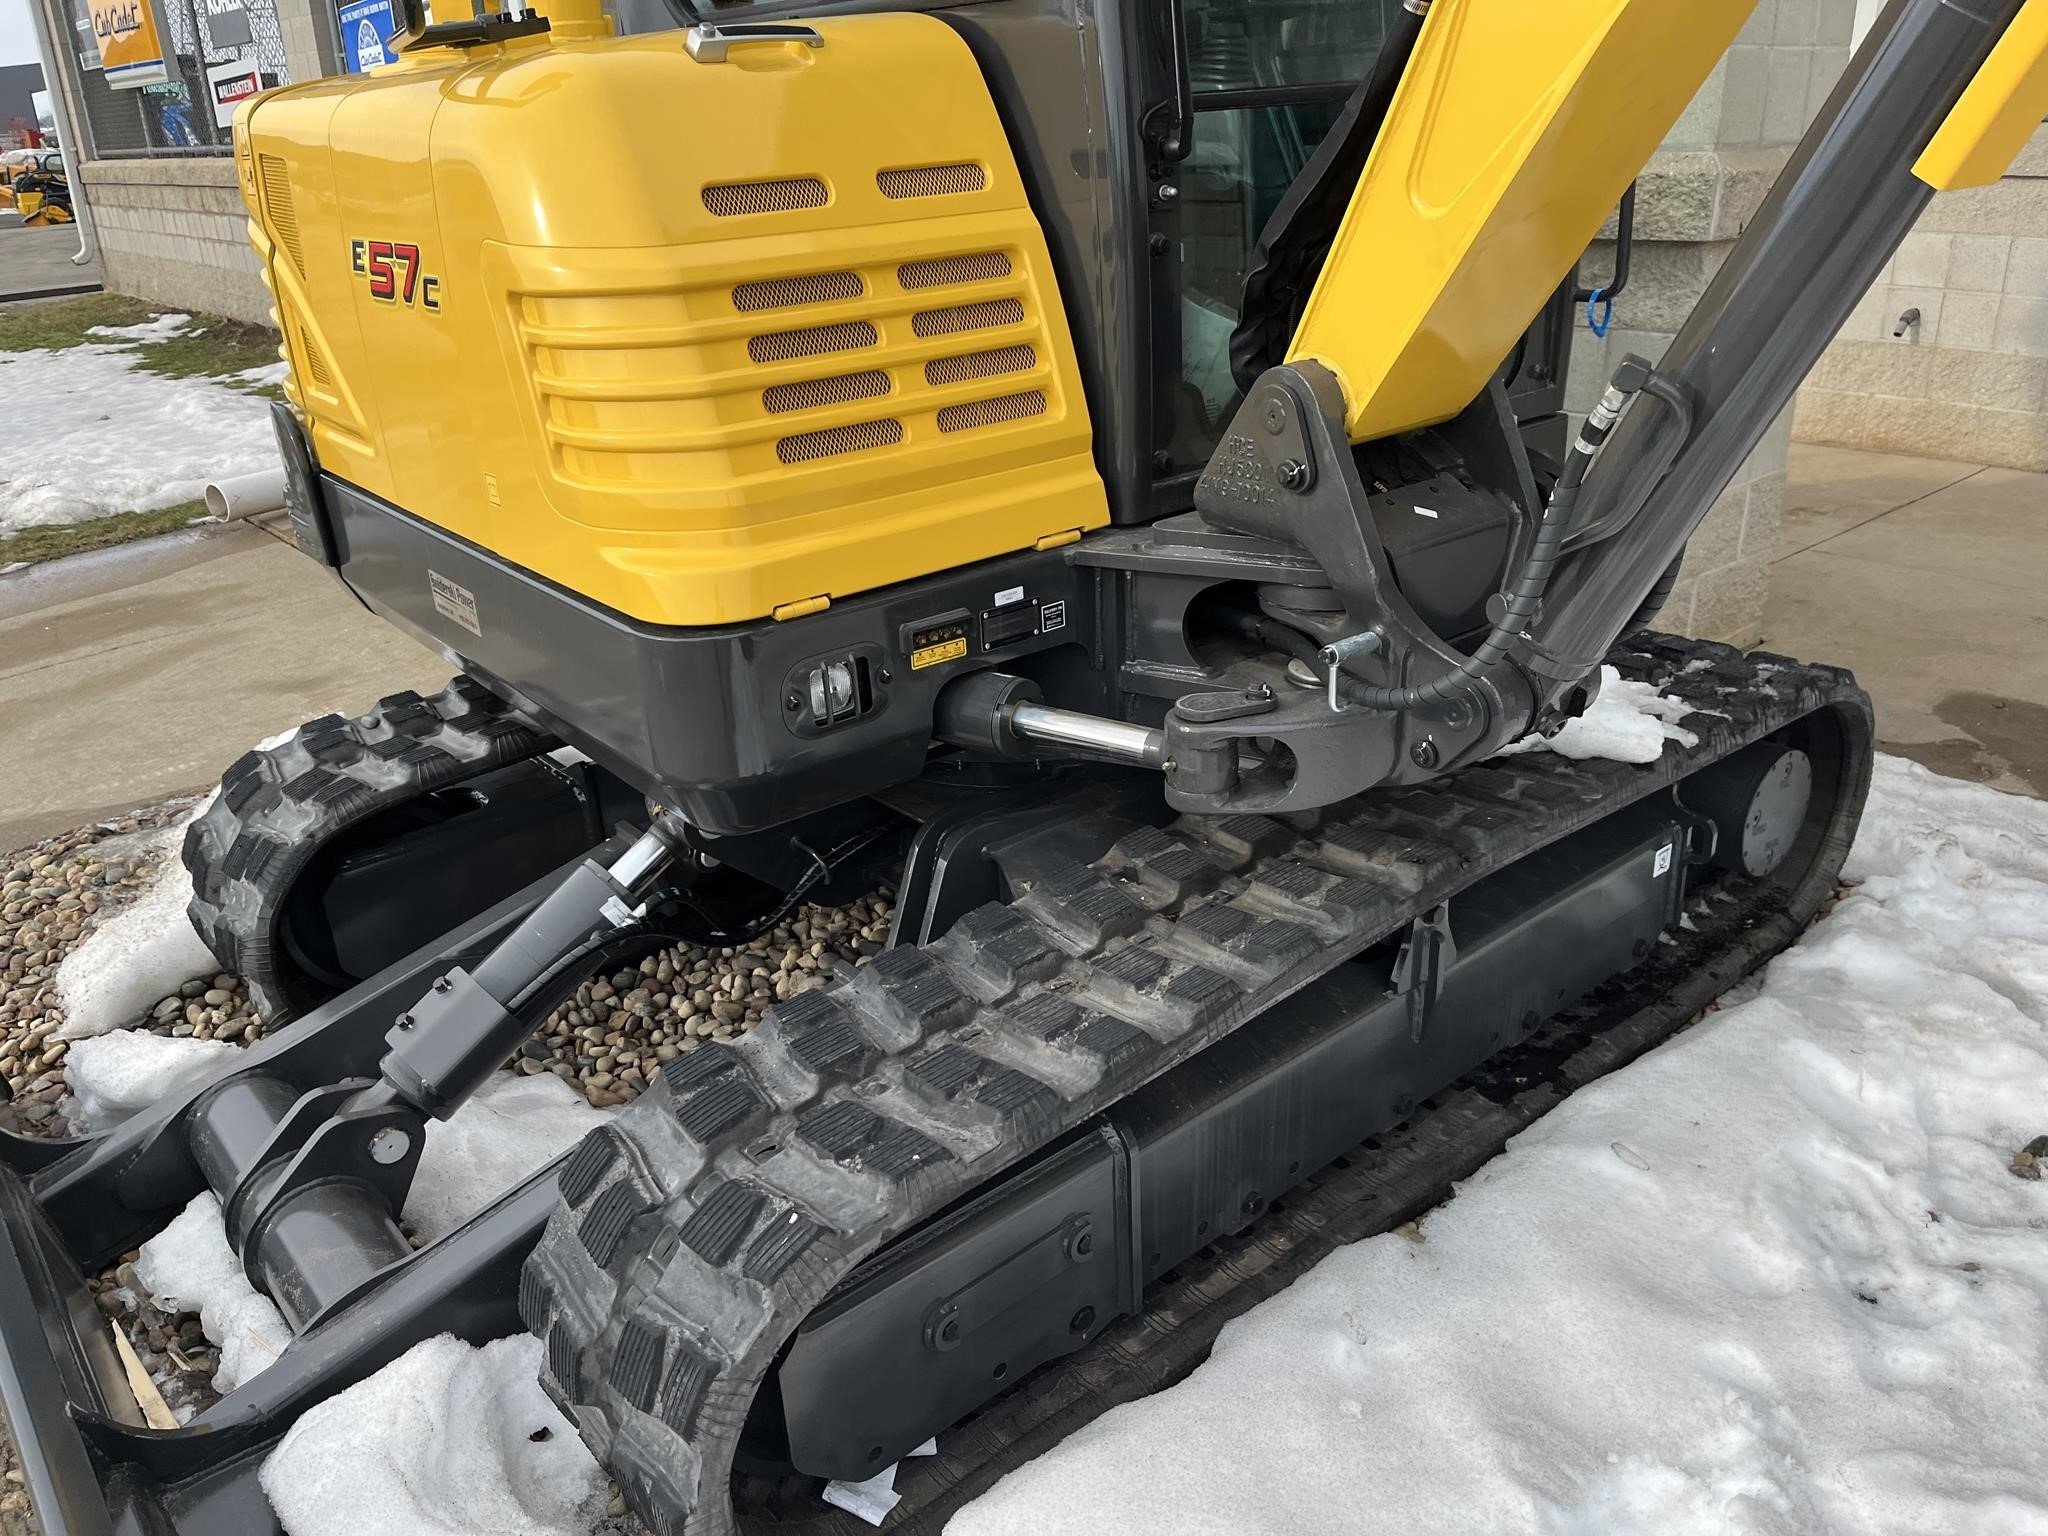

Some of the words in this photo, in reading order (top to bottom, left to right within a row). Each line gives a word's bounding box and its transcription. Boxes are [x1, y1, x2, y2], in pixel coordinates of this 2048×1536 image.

[95, 9, 111, 37] Cub
[111, 2, 139, 33] Cadet
[217, 78, 255, 99] WALLENSTEIN
